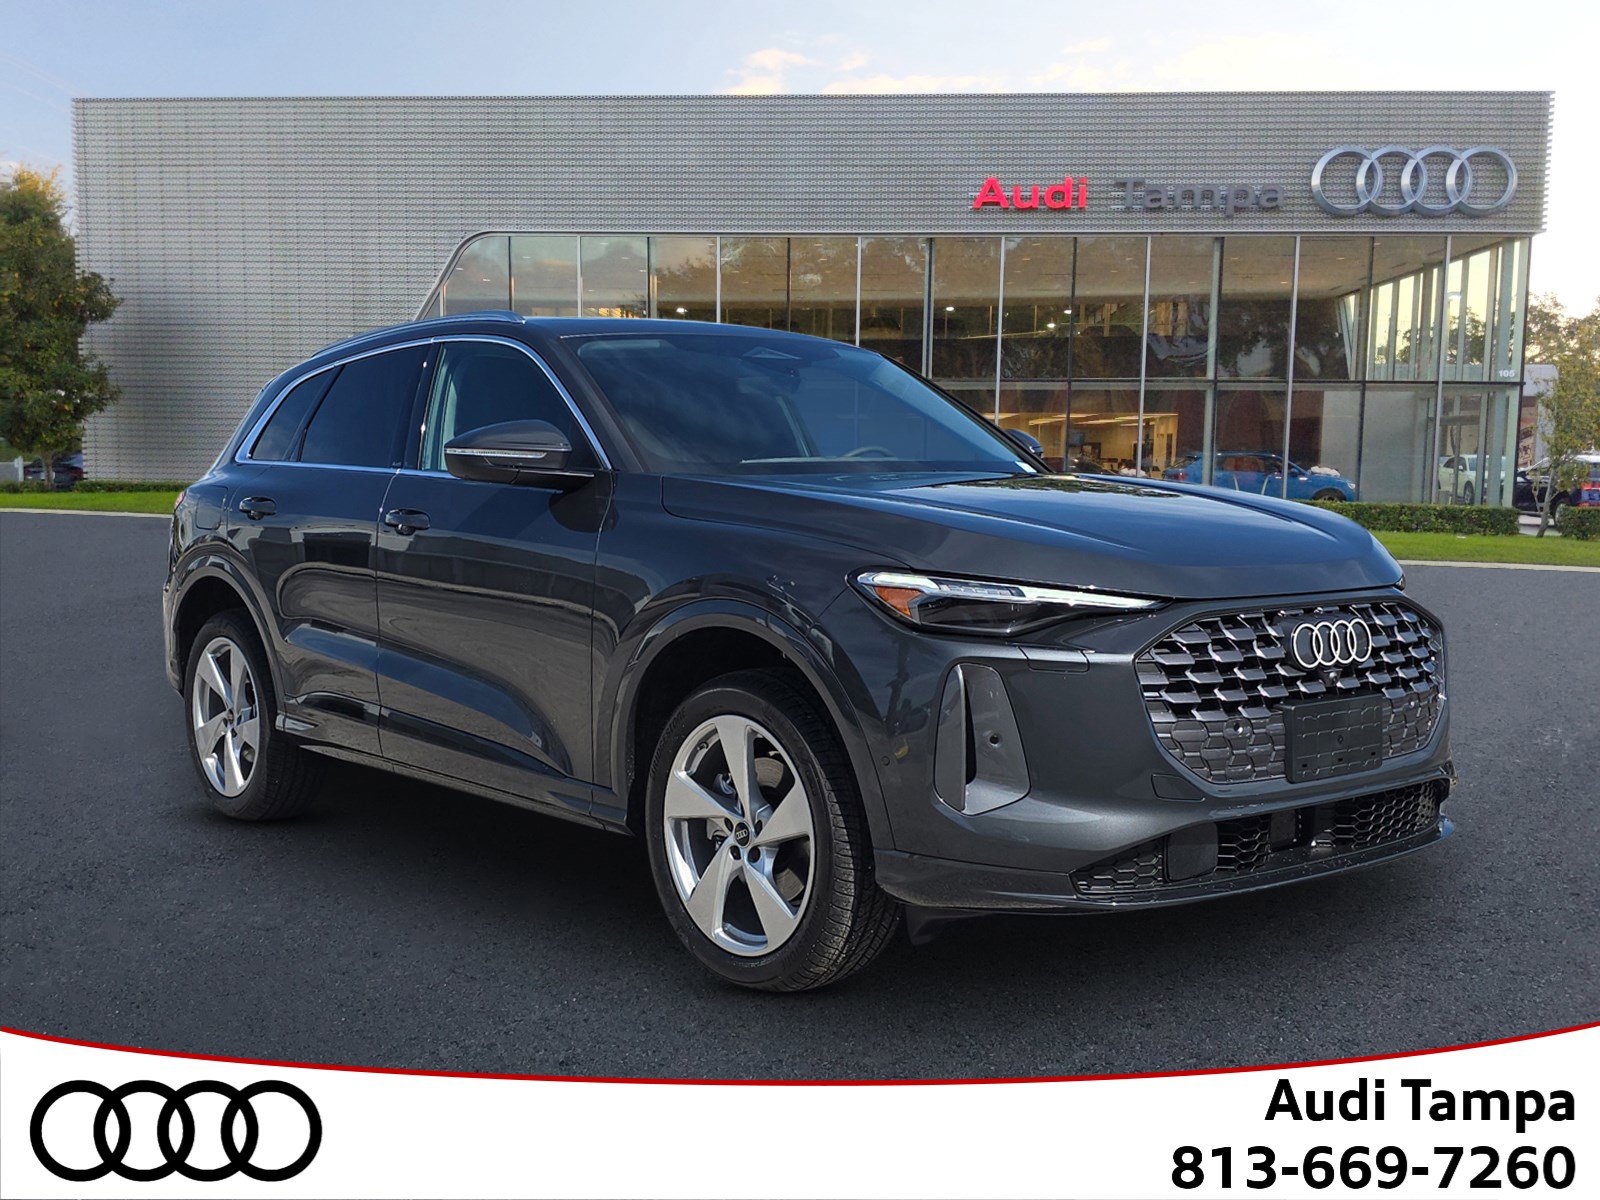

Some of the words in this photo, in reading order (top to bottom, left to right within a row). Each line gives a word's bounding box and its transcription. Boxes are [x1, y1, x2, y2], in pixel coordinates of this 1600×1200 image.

[973, 177, 1087, 209] Audi
[1115, 177, 1284, 218] Tampa
[1498, 369, 1515, 378] 105
